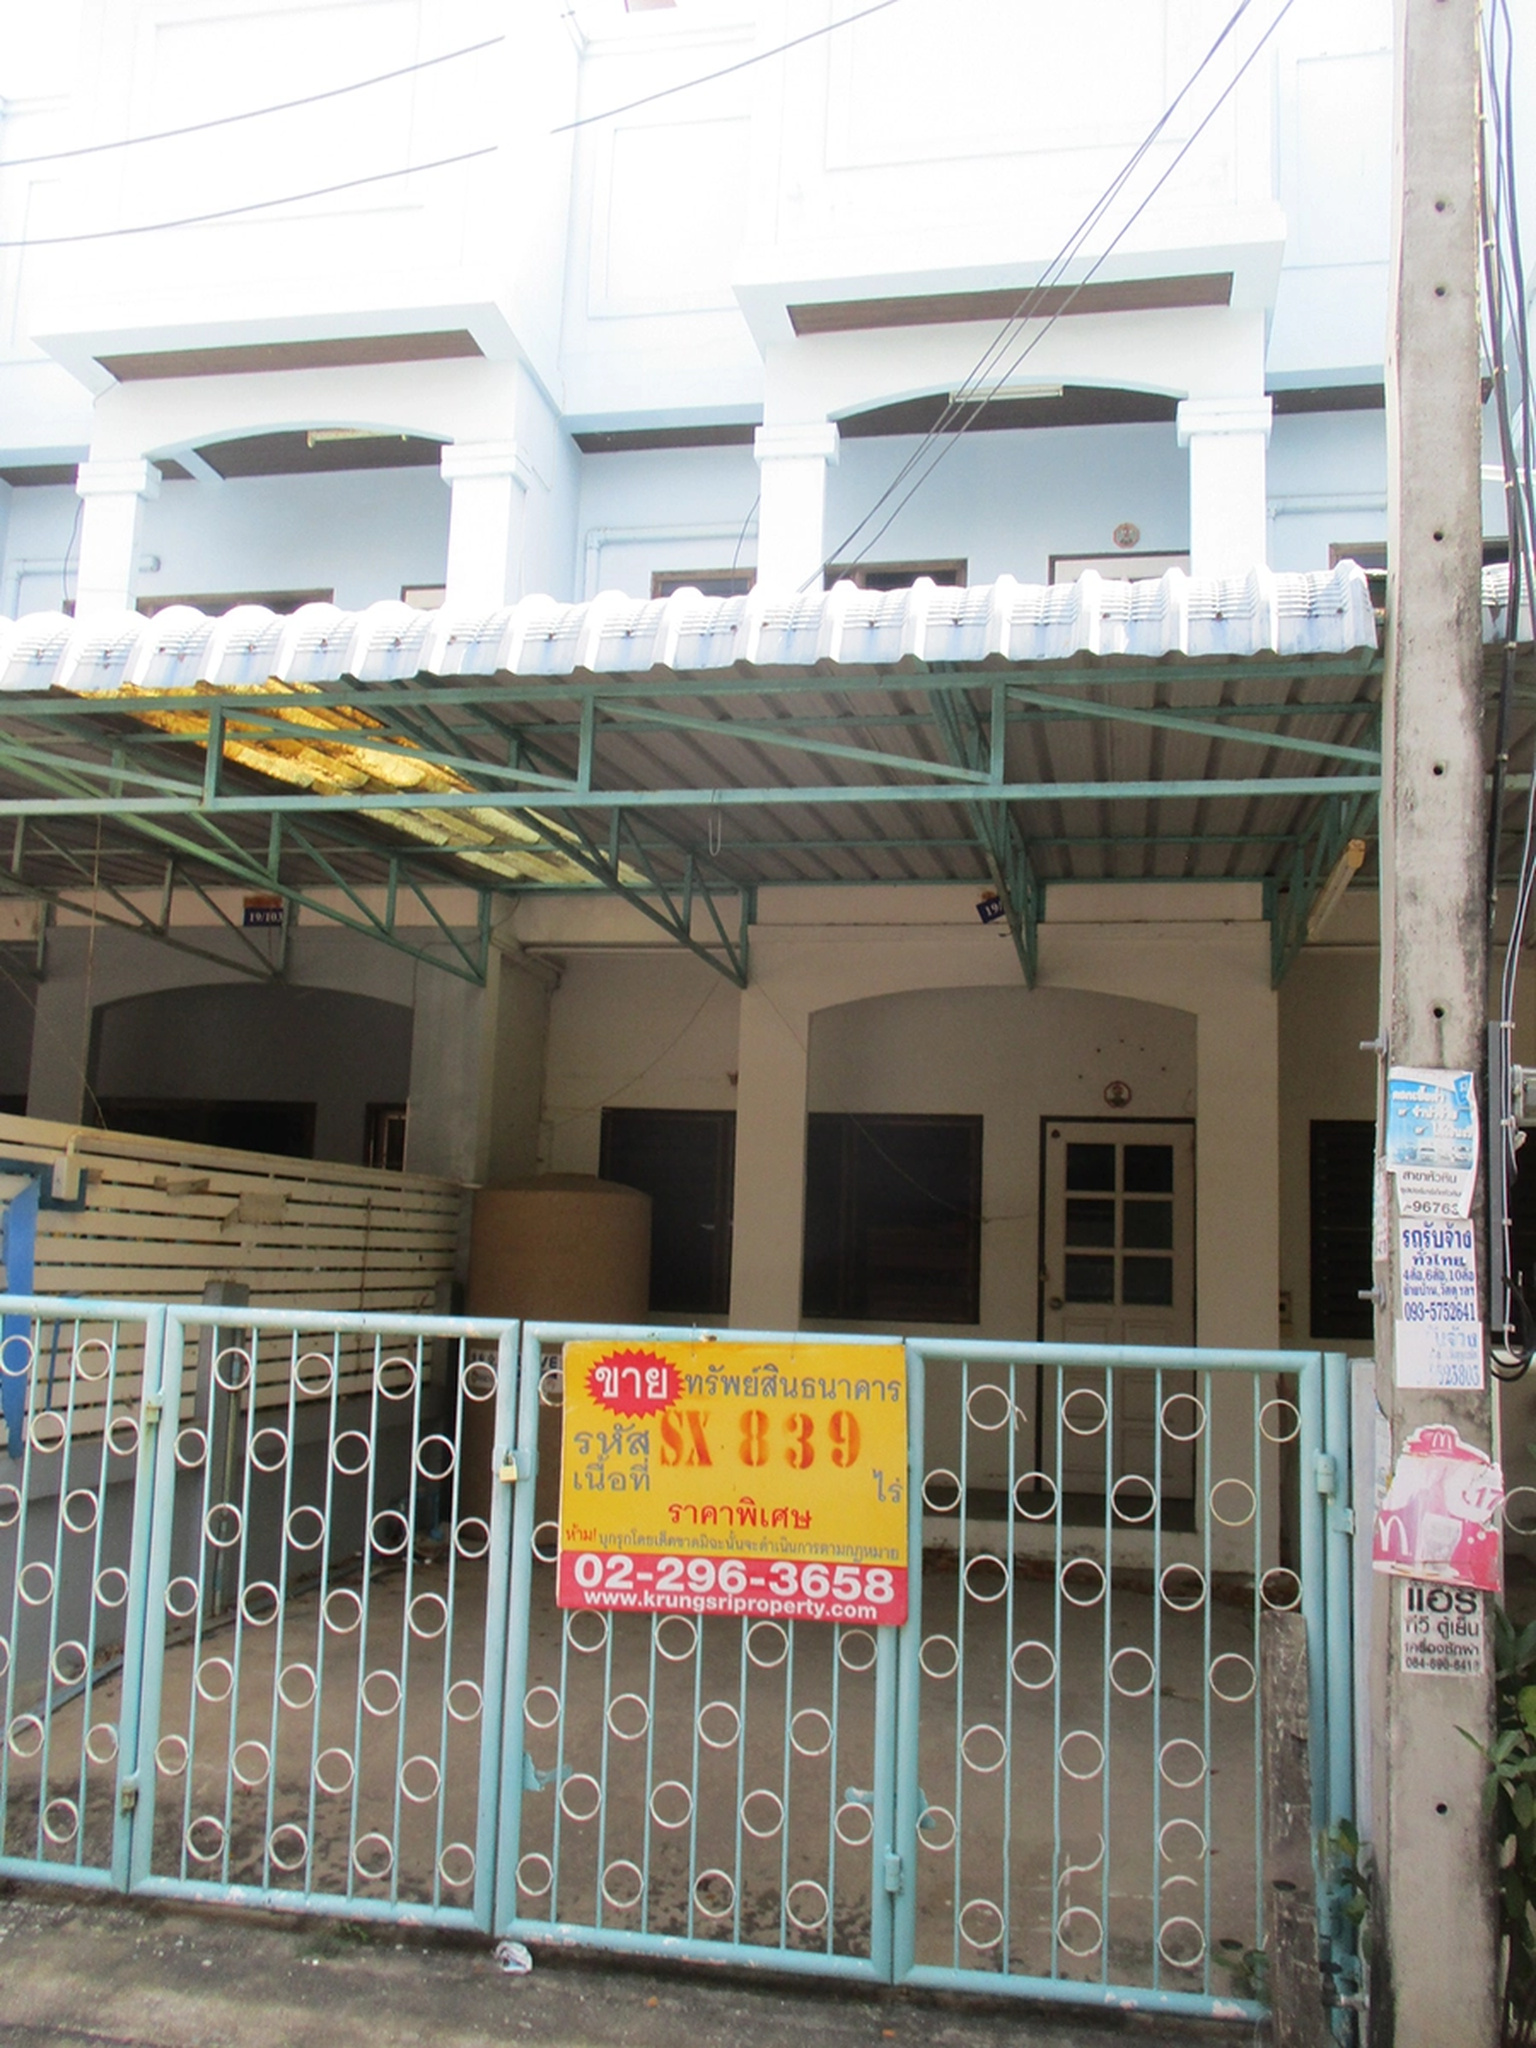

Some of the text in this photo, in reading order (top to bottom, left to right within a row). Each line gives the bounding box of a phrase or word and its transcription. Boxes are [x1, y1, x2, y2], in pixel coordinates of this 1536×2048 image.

[1402, 1220, 1473, 1249] รถรับจ้าง
[1412, 1247, 1467, 1267] ทั่วไทย
[1404, 1301, 1476, 1322] 093-5752641
[594, 1365, 668, 1399] ขาย
[684, 1363, 902, 1402] ทรัพย์สินธนาคาร
[573, 1422, 650, 1456] รหัส
[660, 1409, 713, 1467] SX
[572, 1454, 904, 1504] เนื้อที่ ไร่
[667, 1495, 813, 1531] ราคาพิเศษ
[565, 1523, 598, 1543] ห้าม!
[573, 1552, 896, 1605] 02-296-3658
[583, 1588, 878, 1620] www.krungsriproperty.com
[1436, 1616, 1479, 1640] ตู้เย็น
